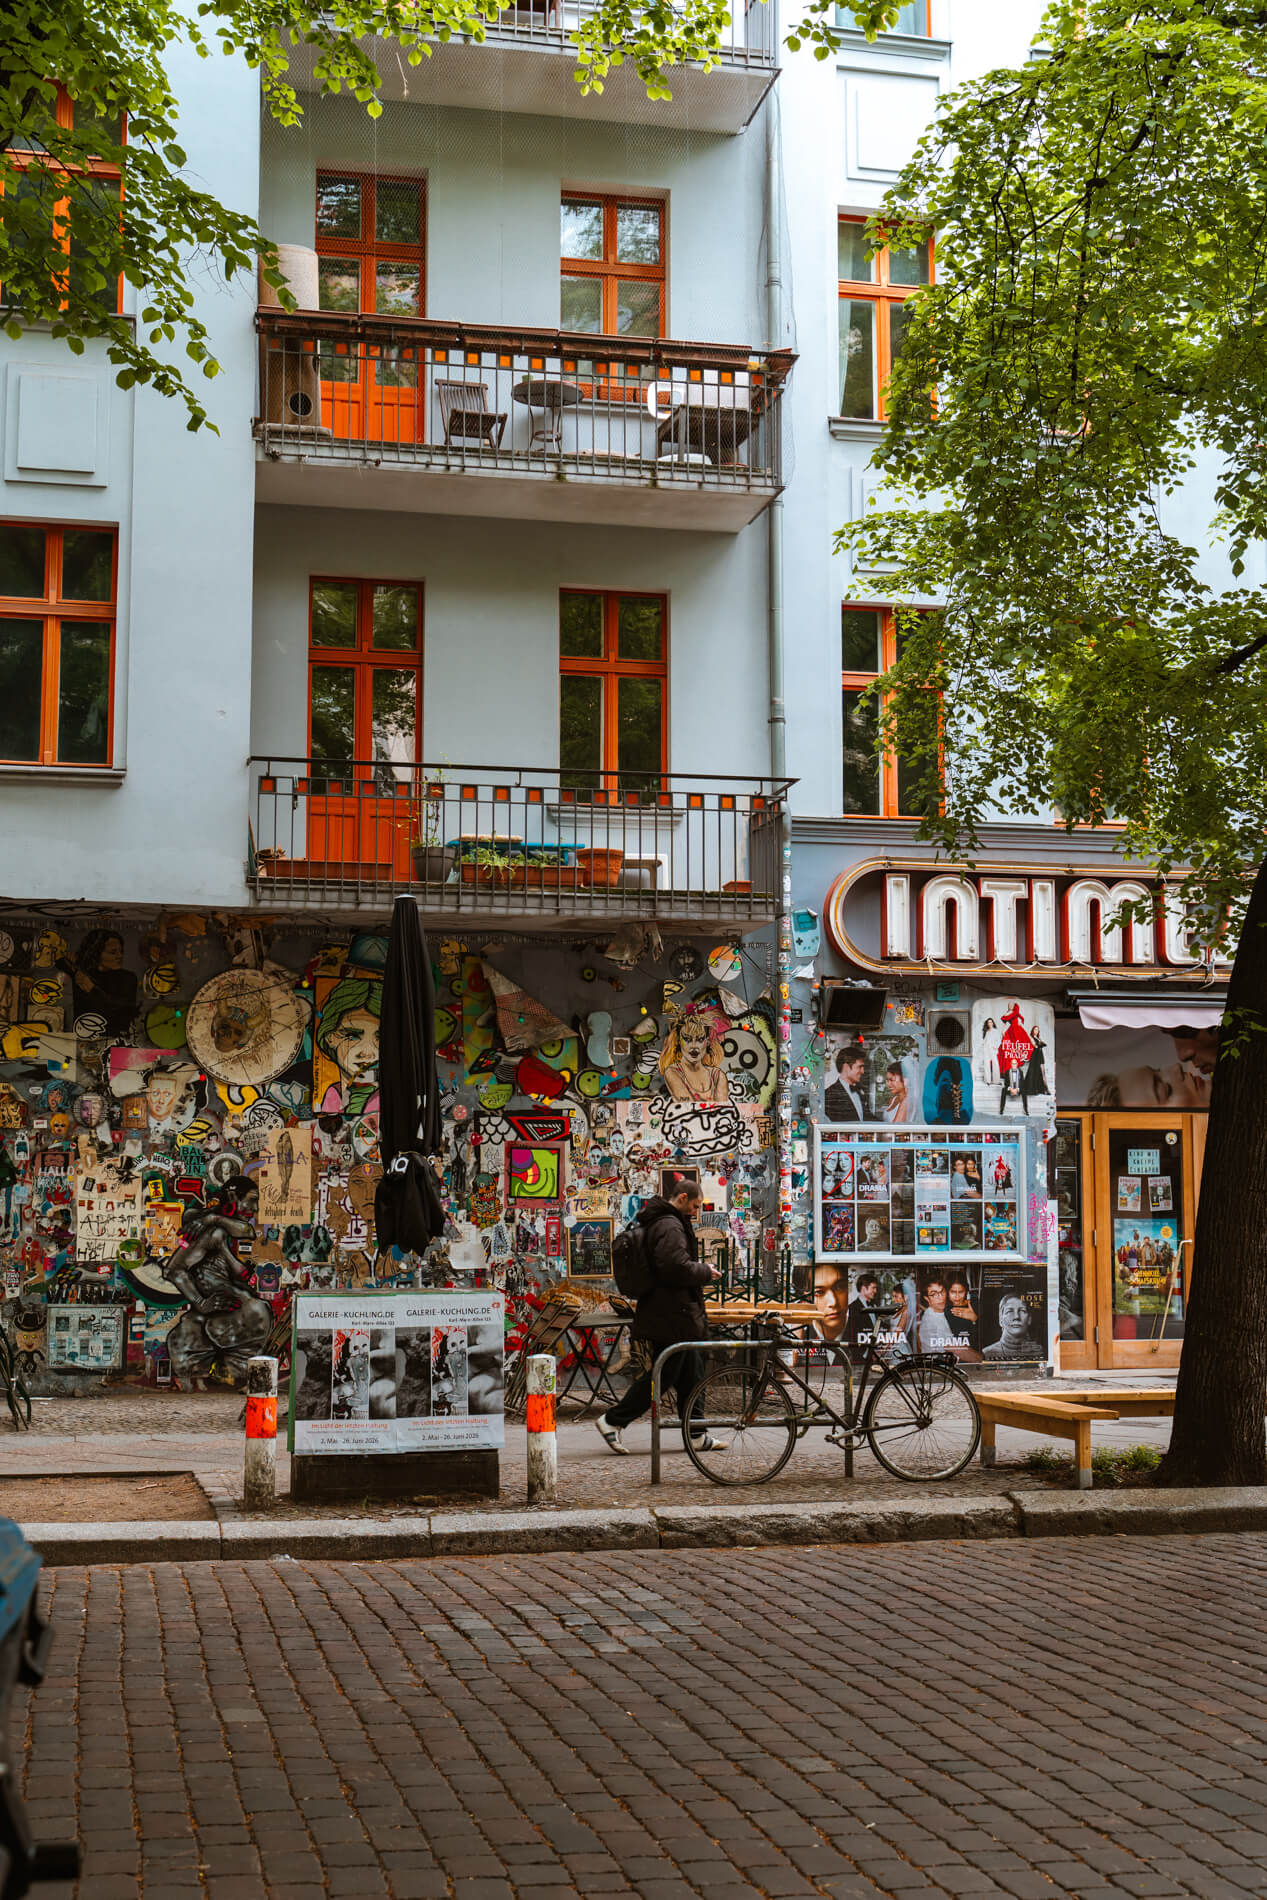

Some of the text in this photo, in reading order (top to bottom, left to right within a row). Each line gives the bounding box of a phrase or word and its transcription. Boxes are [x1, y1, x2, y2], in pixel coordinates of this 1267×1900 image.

[858, 1184, 887, 1192] DRAMA
[1020, 1294, 1044, 1302] ROSE
[406, 1307, 492, 1317] GALERIE-KUCHLING.DE
[929, 1337, 970, 1347] DRAMA
